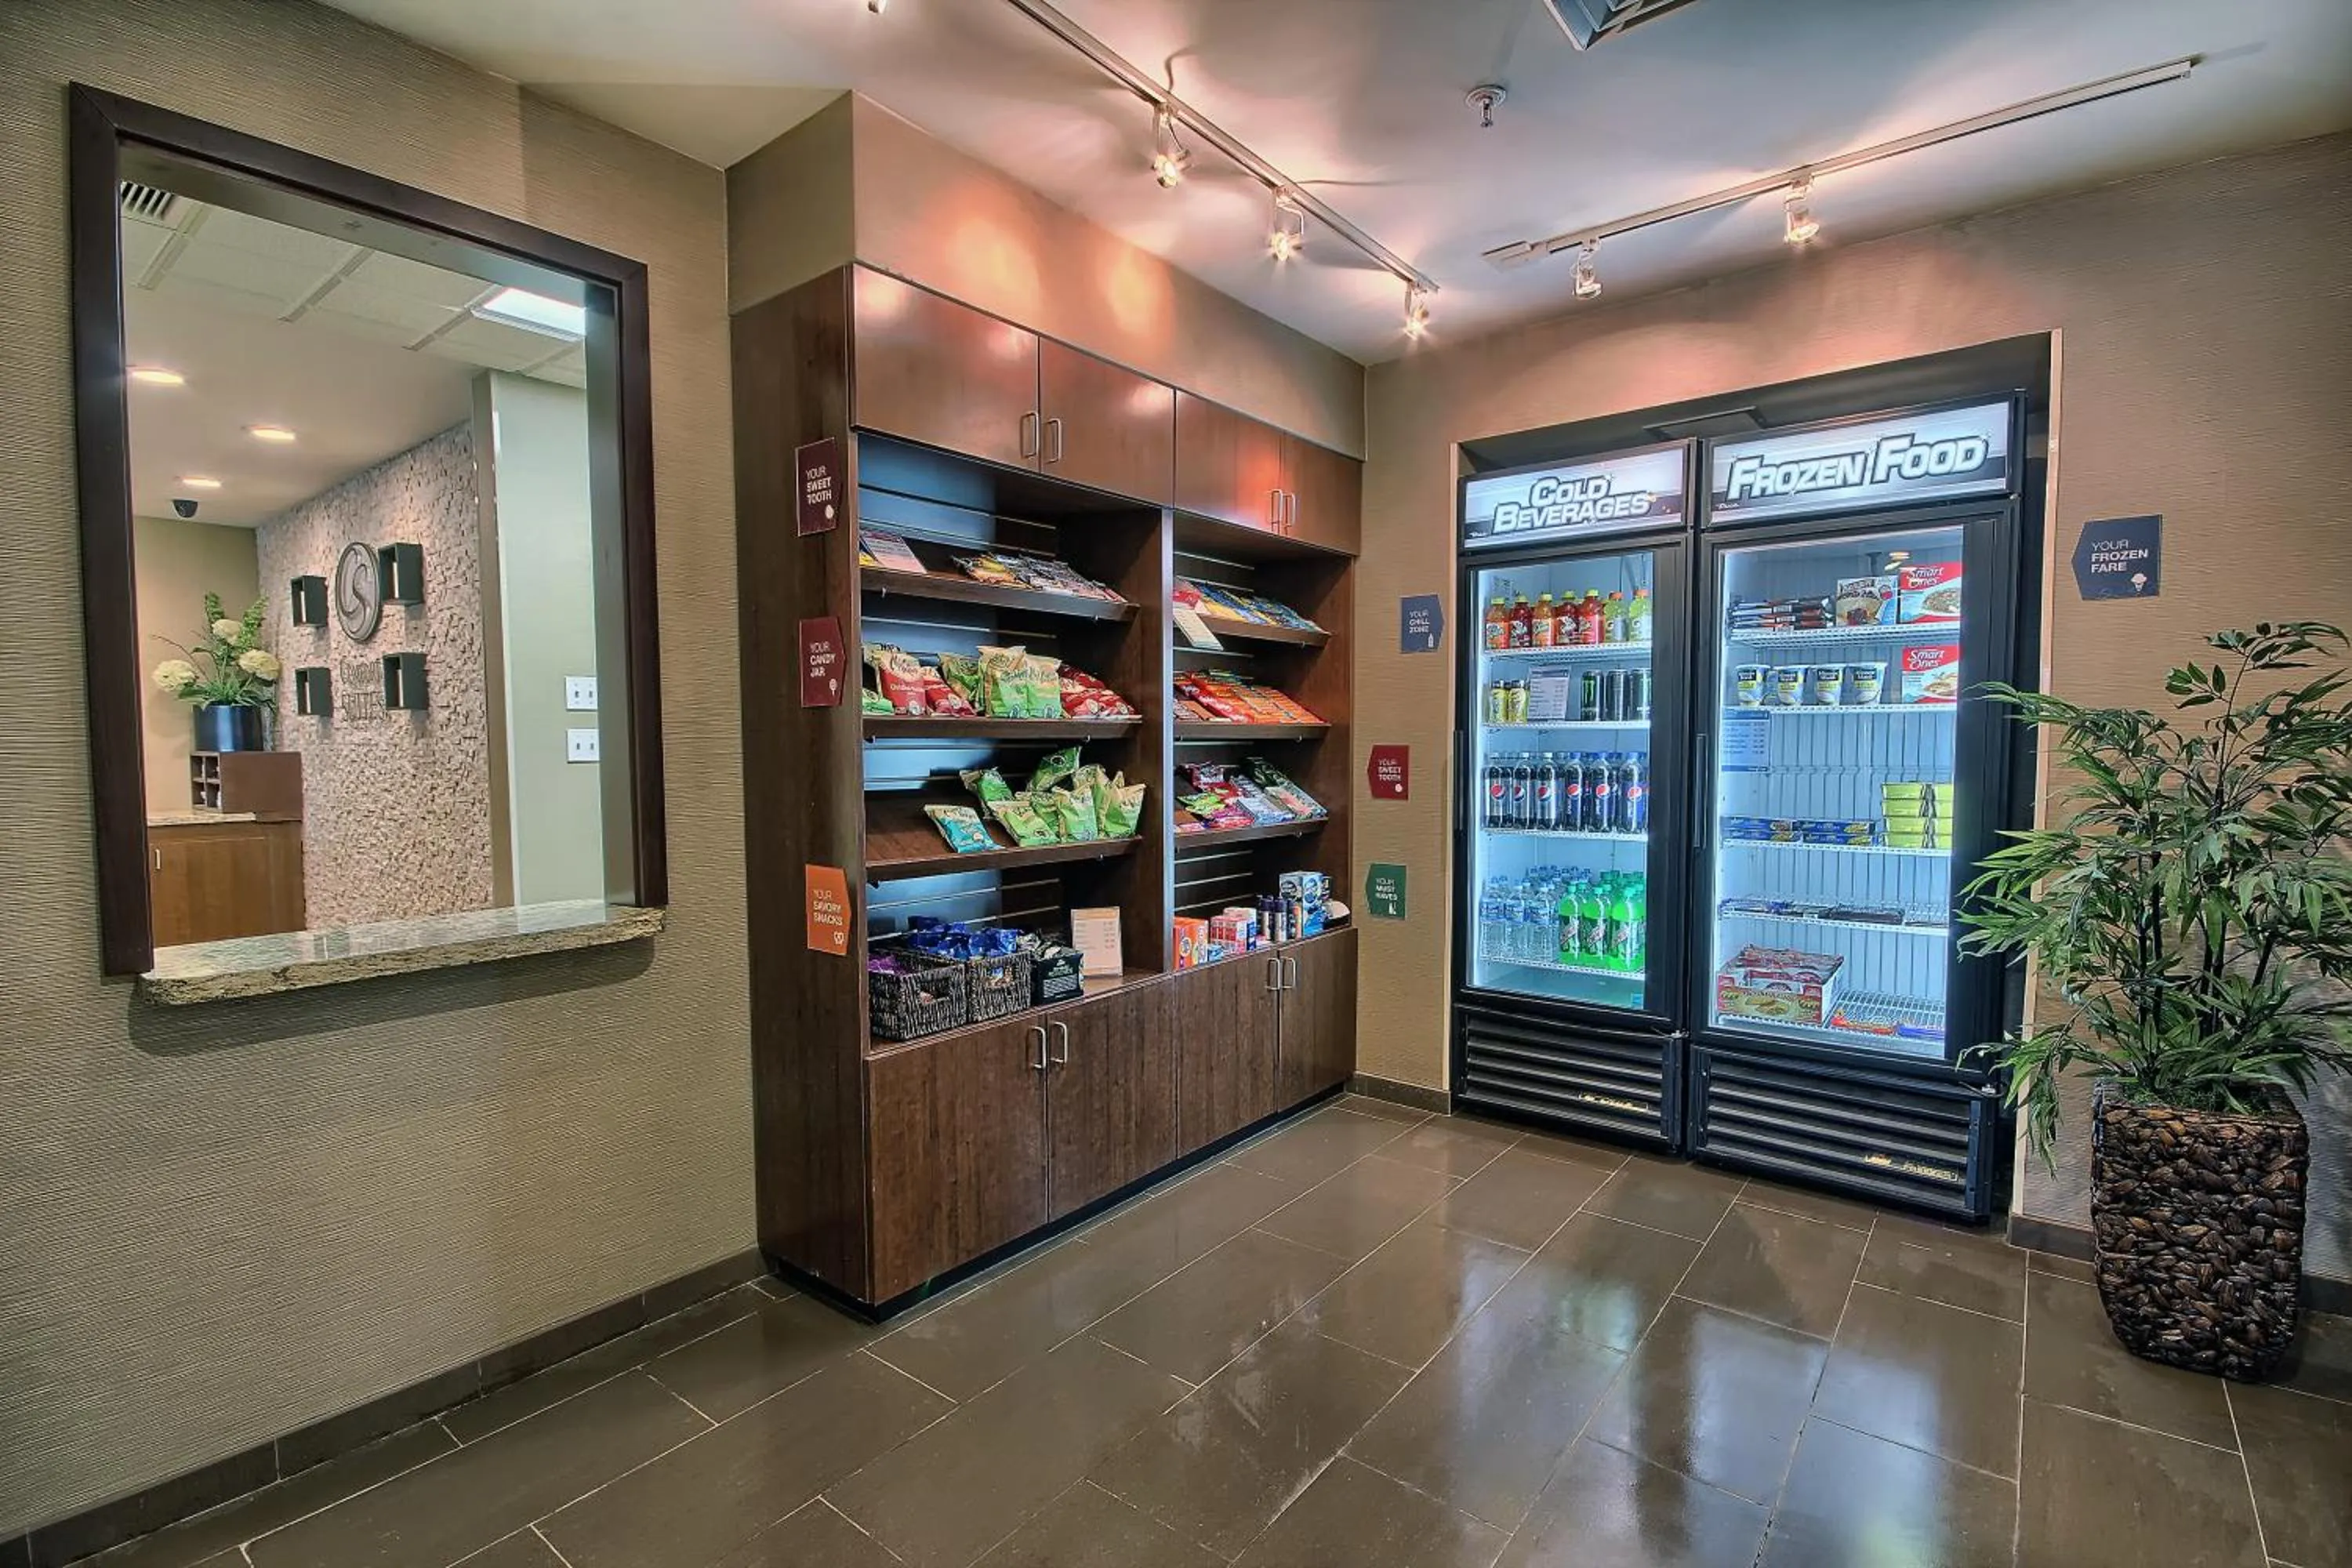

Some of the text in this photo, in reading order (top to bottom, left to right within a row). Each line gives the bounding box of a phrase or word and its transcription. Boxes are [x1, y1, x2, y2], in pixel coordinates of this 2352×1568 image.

[805, 465, 827, 481] YOUR
[1726, 433, 1988, 500] FROZEN FOOD
[806, 476, 832, 492] SWEET
[806, 488, 832, 505] TOOTH
[1530, 476, 1611, 508] COLD
[1492, 491, 1652, 535] BEVERAGES
[2091, 539, 2129, 551] YOUR
[2091, 549, 2148, 562] FROZEN
[1911, 567, 1944, 579] Smart
[2091, 561, 2128, 573] FARE
[1409, 609, 1429, 619] YOUR
[809, 641, 831, 653] YOUR
[810, 653, 837, 666] CANDY
[1910, 649, 1945, 660] Smart
[810, 666, 826, 678] JAR
[1376, 877, 1396, 886] YOUR
[813, 901, 841, 914] SAVORY
[813, 912, 844, 926] SNACKS
